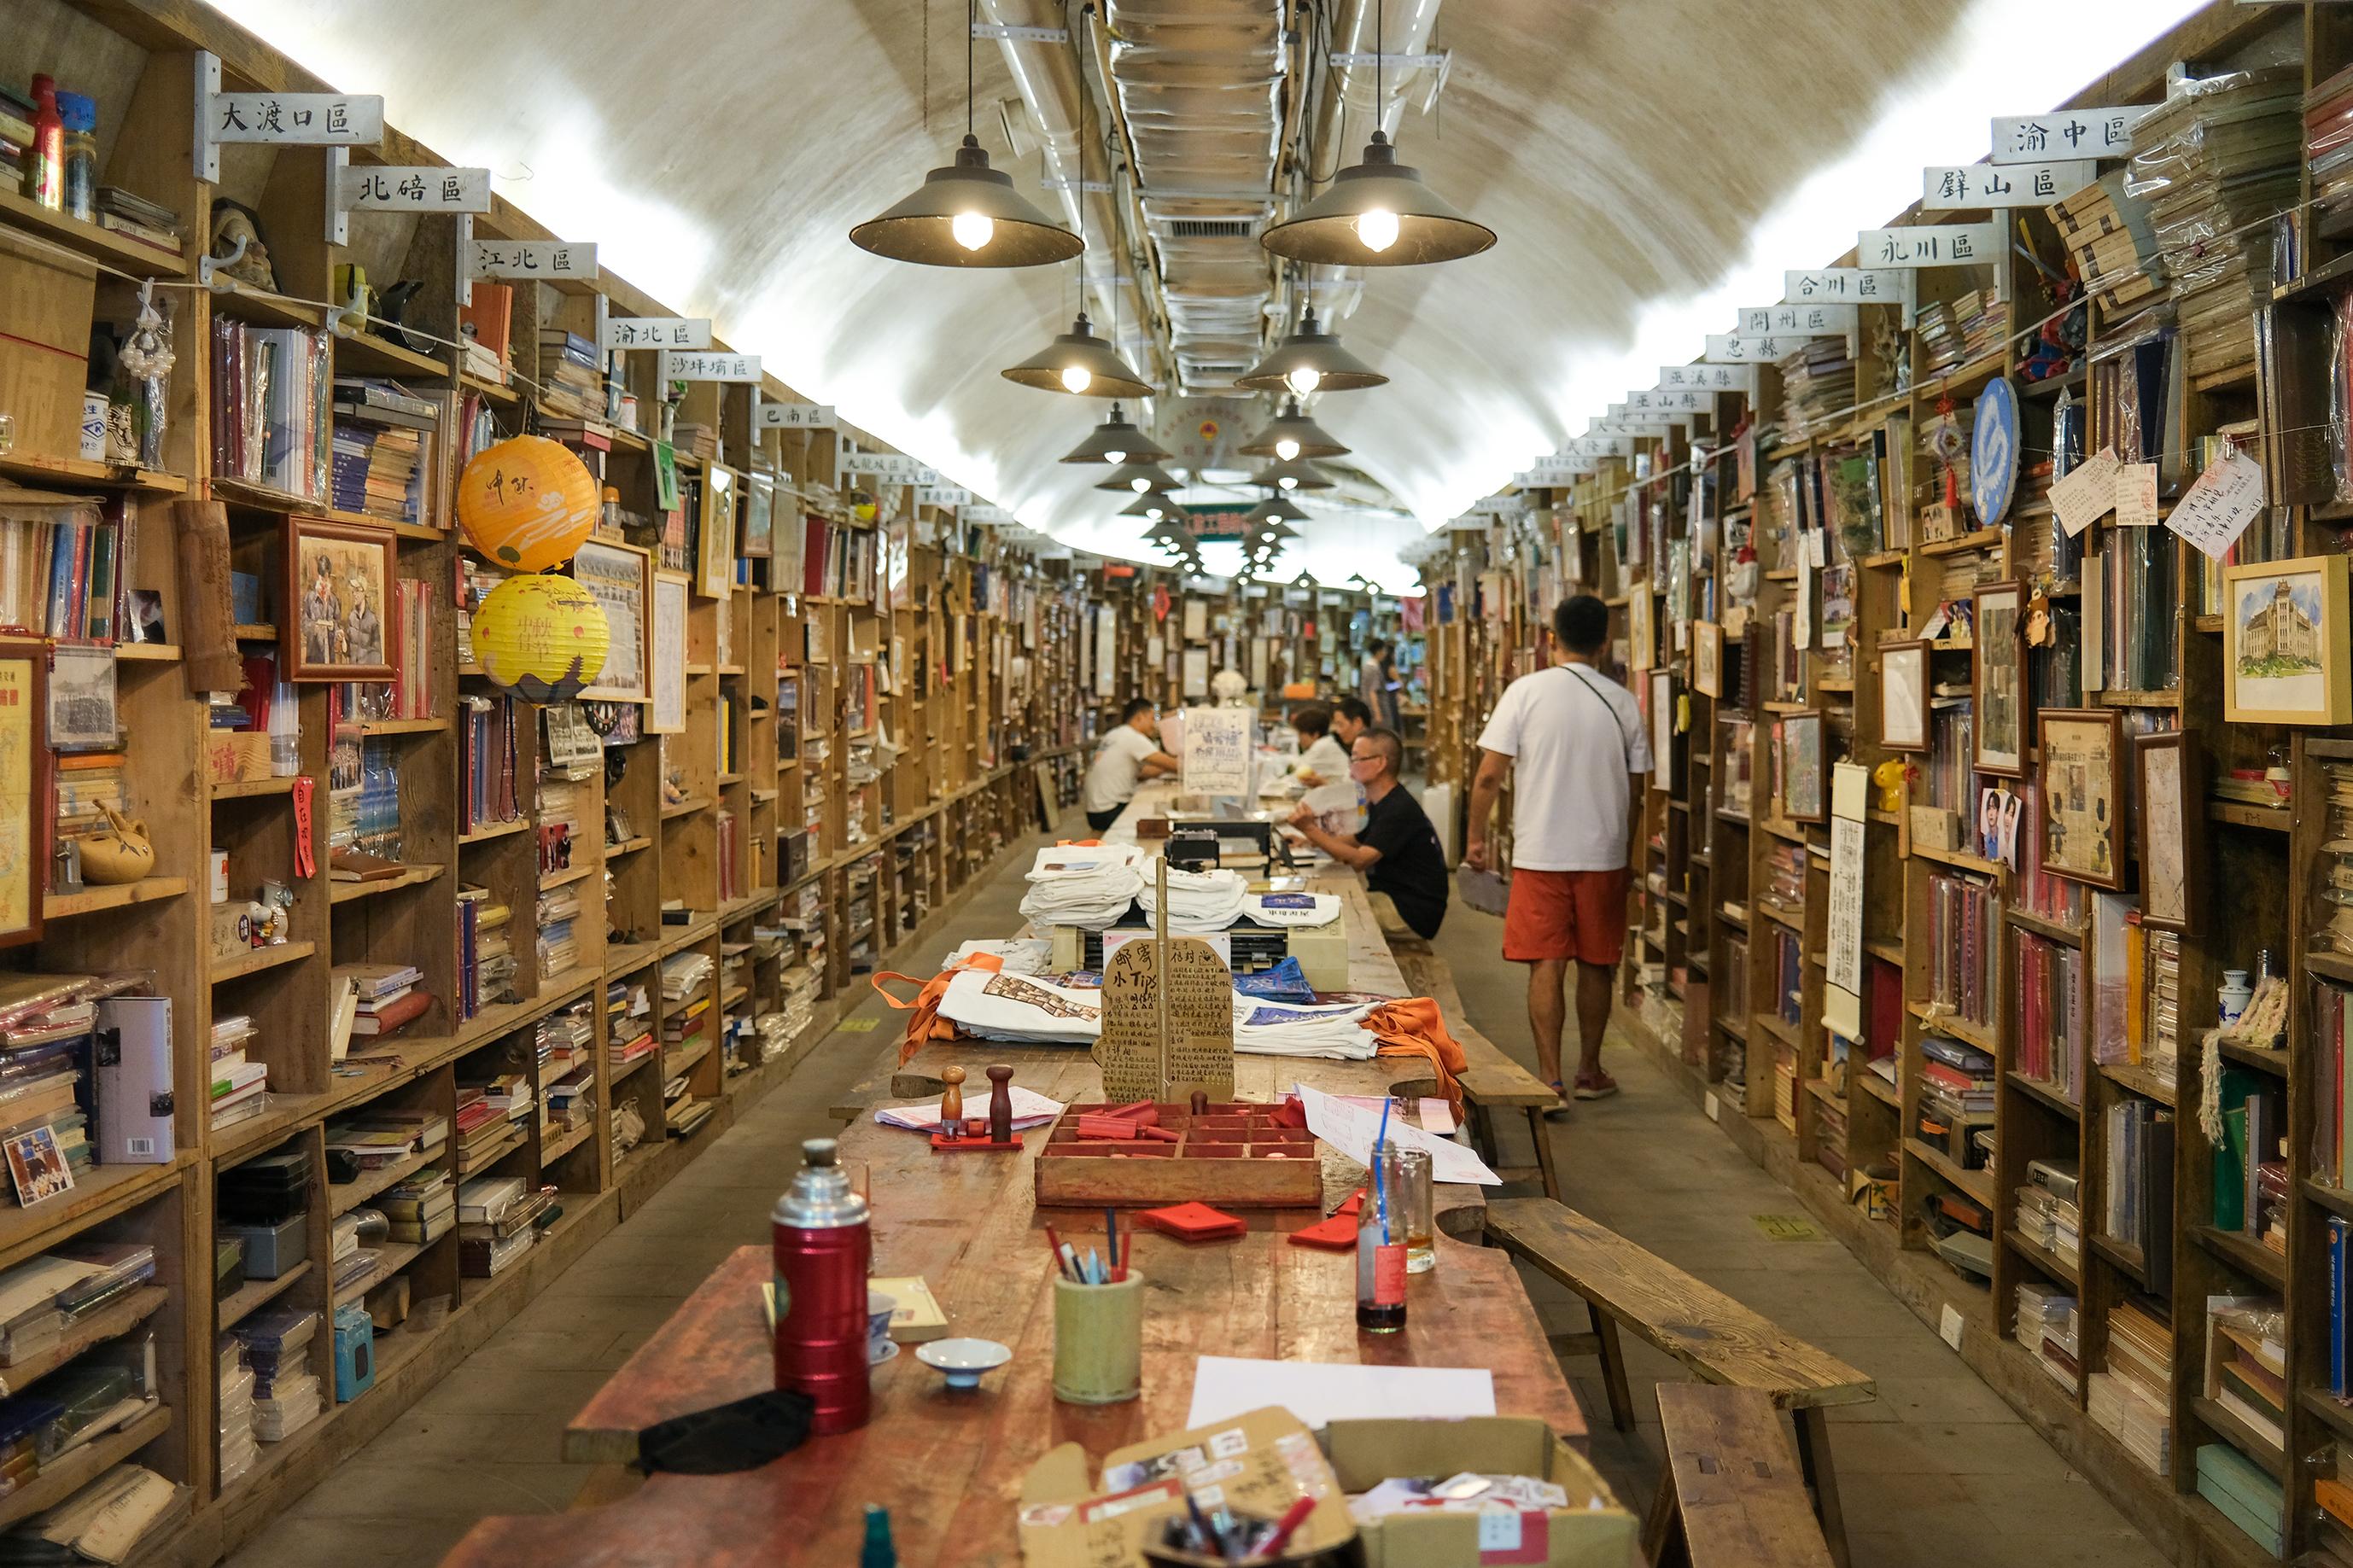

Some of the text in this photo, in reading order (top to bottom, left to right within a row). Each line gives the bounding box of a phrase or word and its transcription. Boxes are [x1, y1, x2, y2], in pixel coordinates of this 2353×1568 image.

[221, 100, 350, 134] 大渡口區
[2016, 116, 2130, 152] 渝中區
[359, 173, 463, 202] 北碚區
[1937, 169, 2056, 201] 璧山區
[478, 248, 572, 271] 江北區
[1881, 234, 1974, 264] 永川區
[1798, 274, 1877, 296] 合川區
[1749, 309, 1825, 332] 開州區
[615, 324, 691, 345] 渝北區
[671, 356, 749, 376] 沙坪壩區
[766, 407, 822, 425] 巴南區
[1115, 942, 1153, 971] 邮寄
